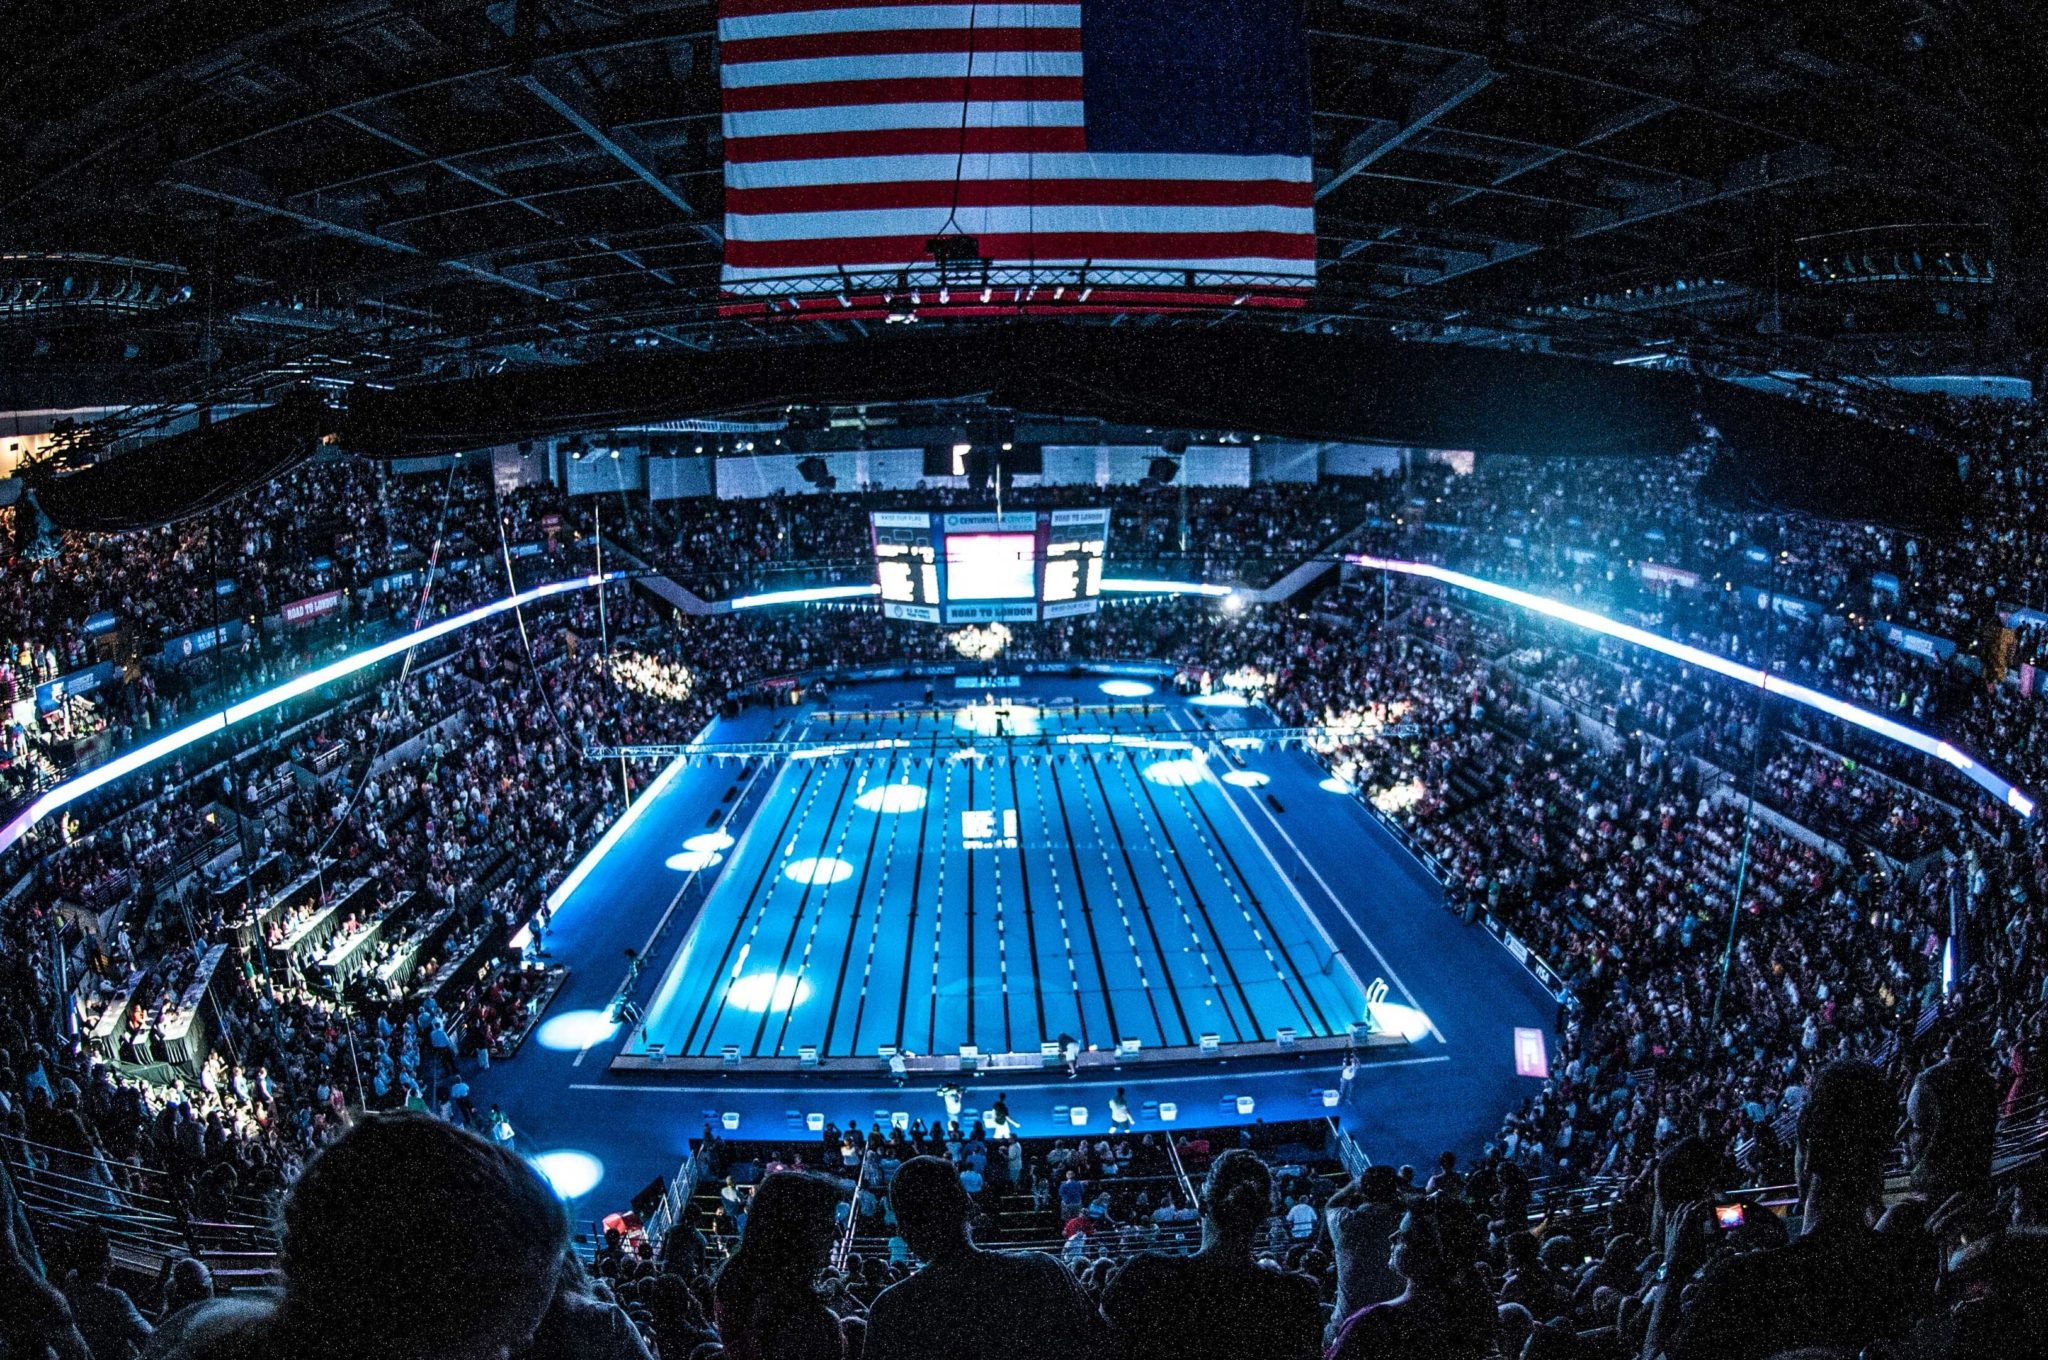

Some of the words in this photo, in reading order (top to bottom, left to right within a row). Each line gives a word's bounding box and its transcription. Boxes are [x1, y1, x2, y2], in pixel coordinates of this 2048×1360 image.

[959, 516, 1007, 525] CENTURYLIK
[1054, 514, 1070, 522] ROAD
[1071, 513, 1080, 522] TO
[1080, 512, 1103, 521] LONDON
[287, 605, 304, 621] ROAD
[305, 602, 314, 616] TO
[314, 594, 338, 613] LONDON
[951, 608, 977, 618] ROAD
[979, 608, 993, 617] TO
[994, 606, 1033, 617] LONDON
[1535, 963, 1550, 984] VISA
